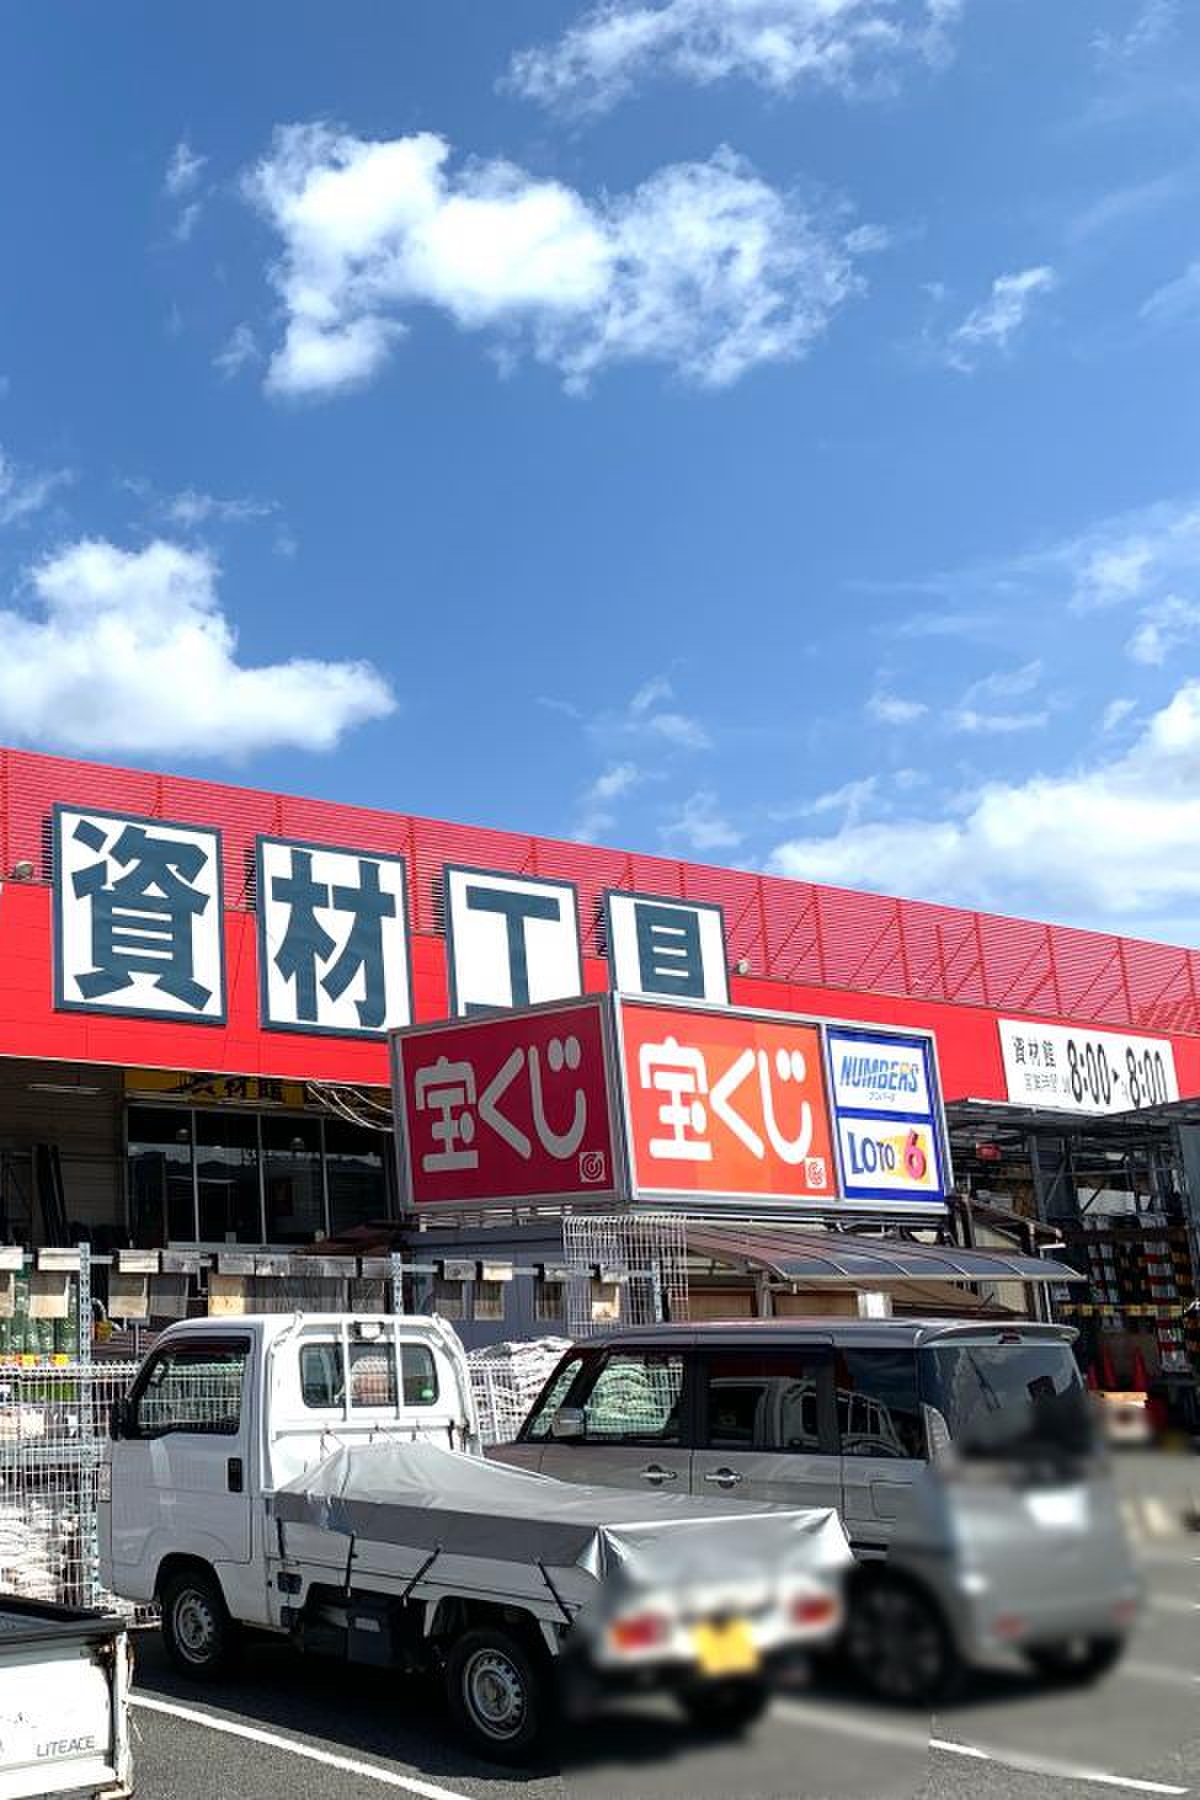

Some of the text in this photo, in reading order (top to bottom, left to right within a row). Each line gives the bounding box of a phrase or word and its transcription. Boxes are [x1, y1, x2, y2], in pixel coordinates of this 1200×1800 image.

[639, 1036, 813, 1165] 宝くじ
[839, 1055, 919, 1093] NUMBERS
[1066, 1039, 1169, 1109] 8:00 8:00
[414, 1036, 588, 1173] 宝くじ
[847, 1129, 927, 1180] LOTO 6
[36, 1735, 96, 1757] LITEACE
